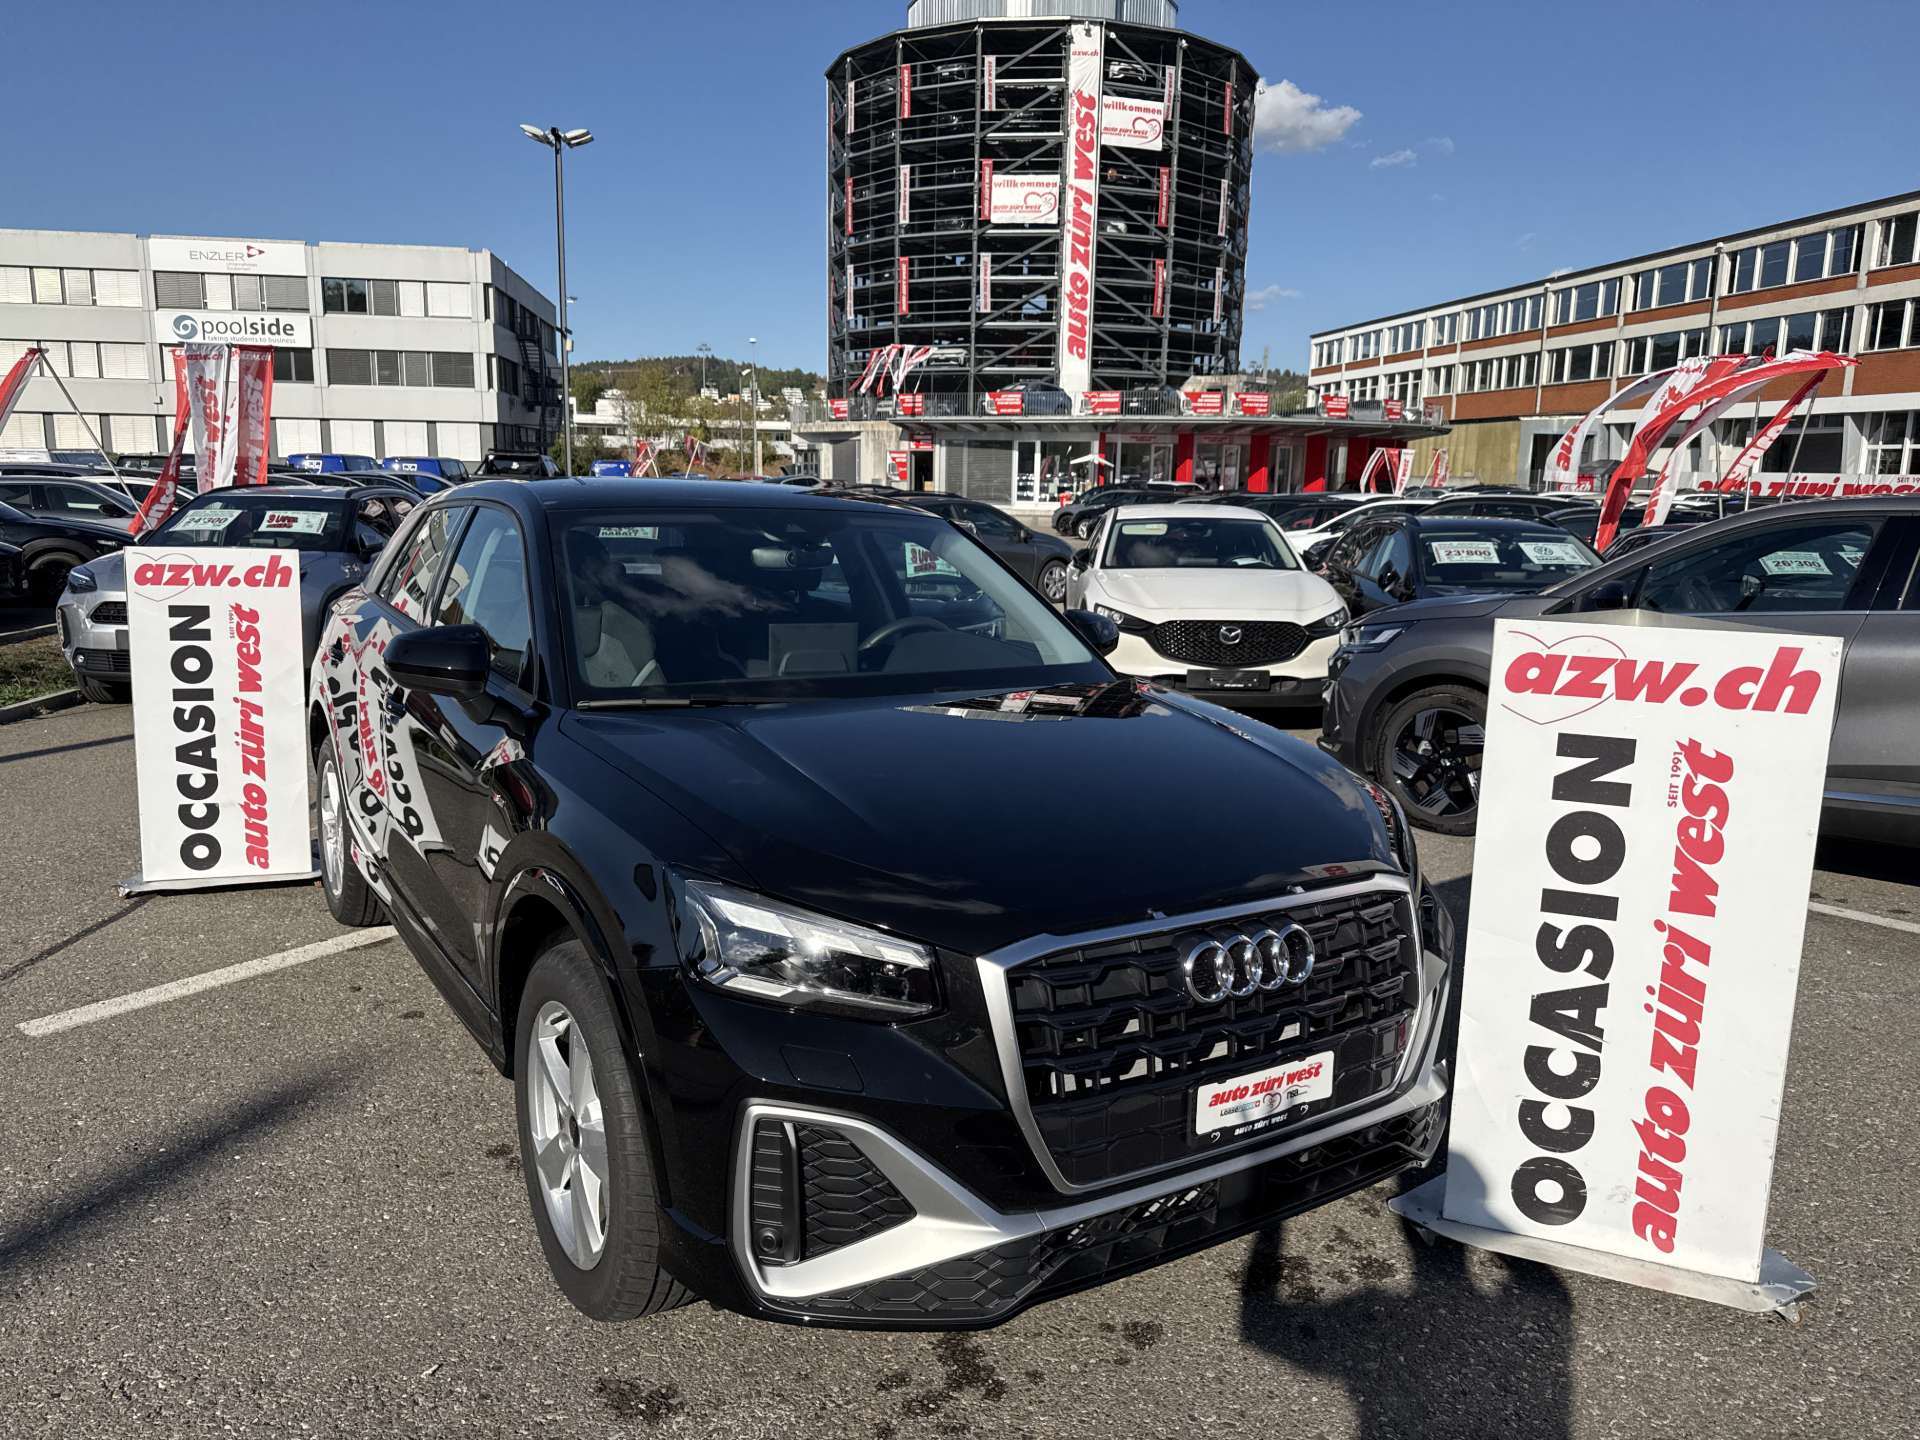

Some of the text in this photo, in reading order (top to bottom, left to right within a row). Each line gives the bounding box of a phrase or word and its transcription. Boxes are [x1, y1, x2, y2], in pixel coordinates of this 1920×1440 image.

[1103, 101, 1162, 116] willkommen
[993, 180, 1058, 188] willkommen
[1065, 88, 1097, 361] auto züri west
[190, 250, 245, 262] ENZLER
[201, 316, 295, 341] poolside
[208, 335, 229, 343] taking
[1444, 549, 1491, 557] 23'800
[1772, 560, 1822, 568] 26'300
[134, 555, 293, 588] azw.ch
[1504, 646, 1822, 715] azw.ch
[168, 605, 222, 871] OCCASION
[229, 602, 270, 870] auto züri west
[1667, 751, 1683, 808] SEIT 1991
[1510, 732, 1637, 1227] OCCASION
[1631, 737, 1735, 1254] auto züri west
[1208, 1062, 1323, 1107] auto züri west
[1234, 1113, 1288, 1136] auto züri west
